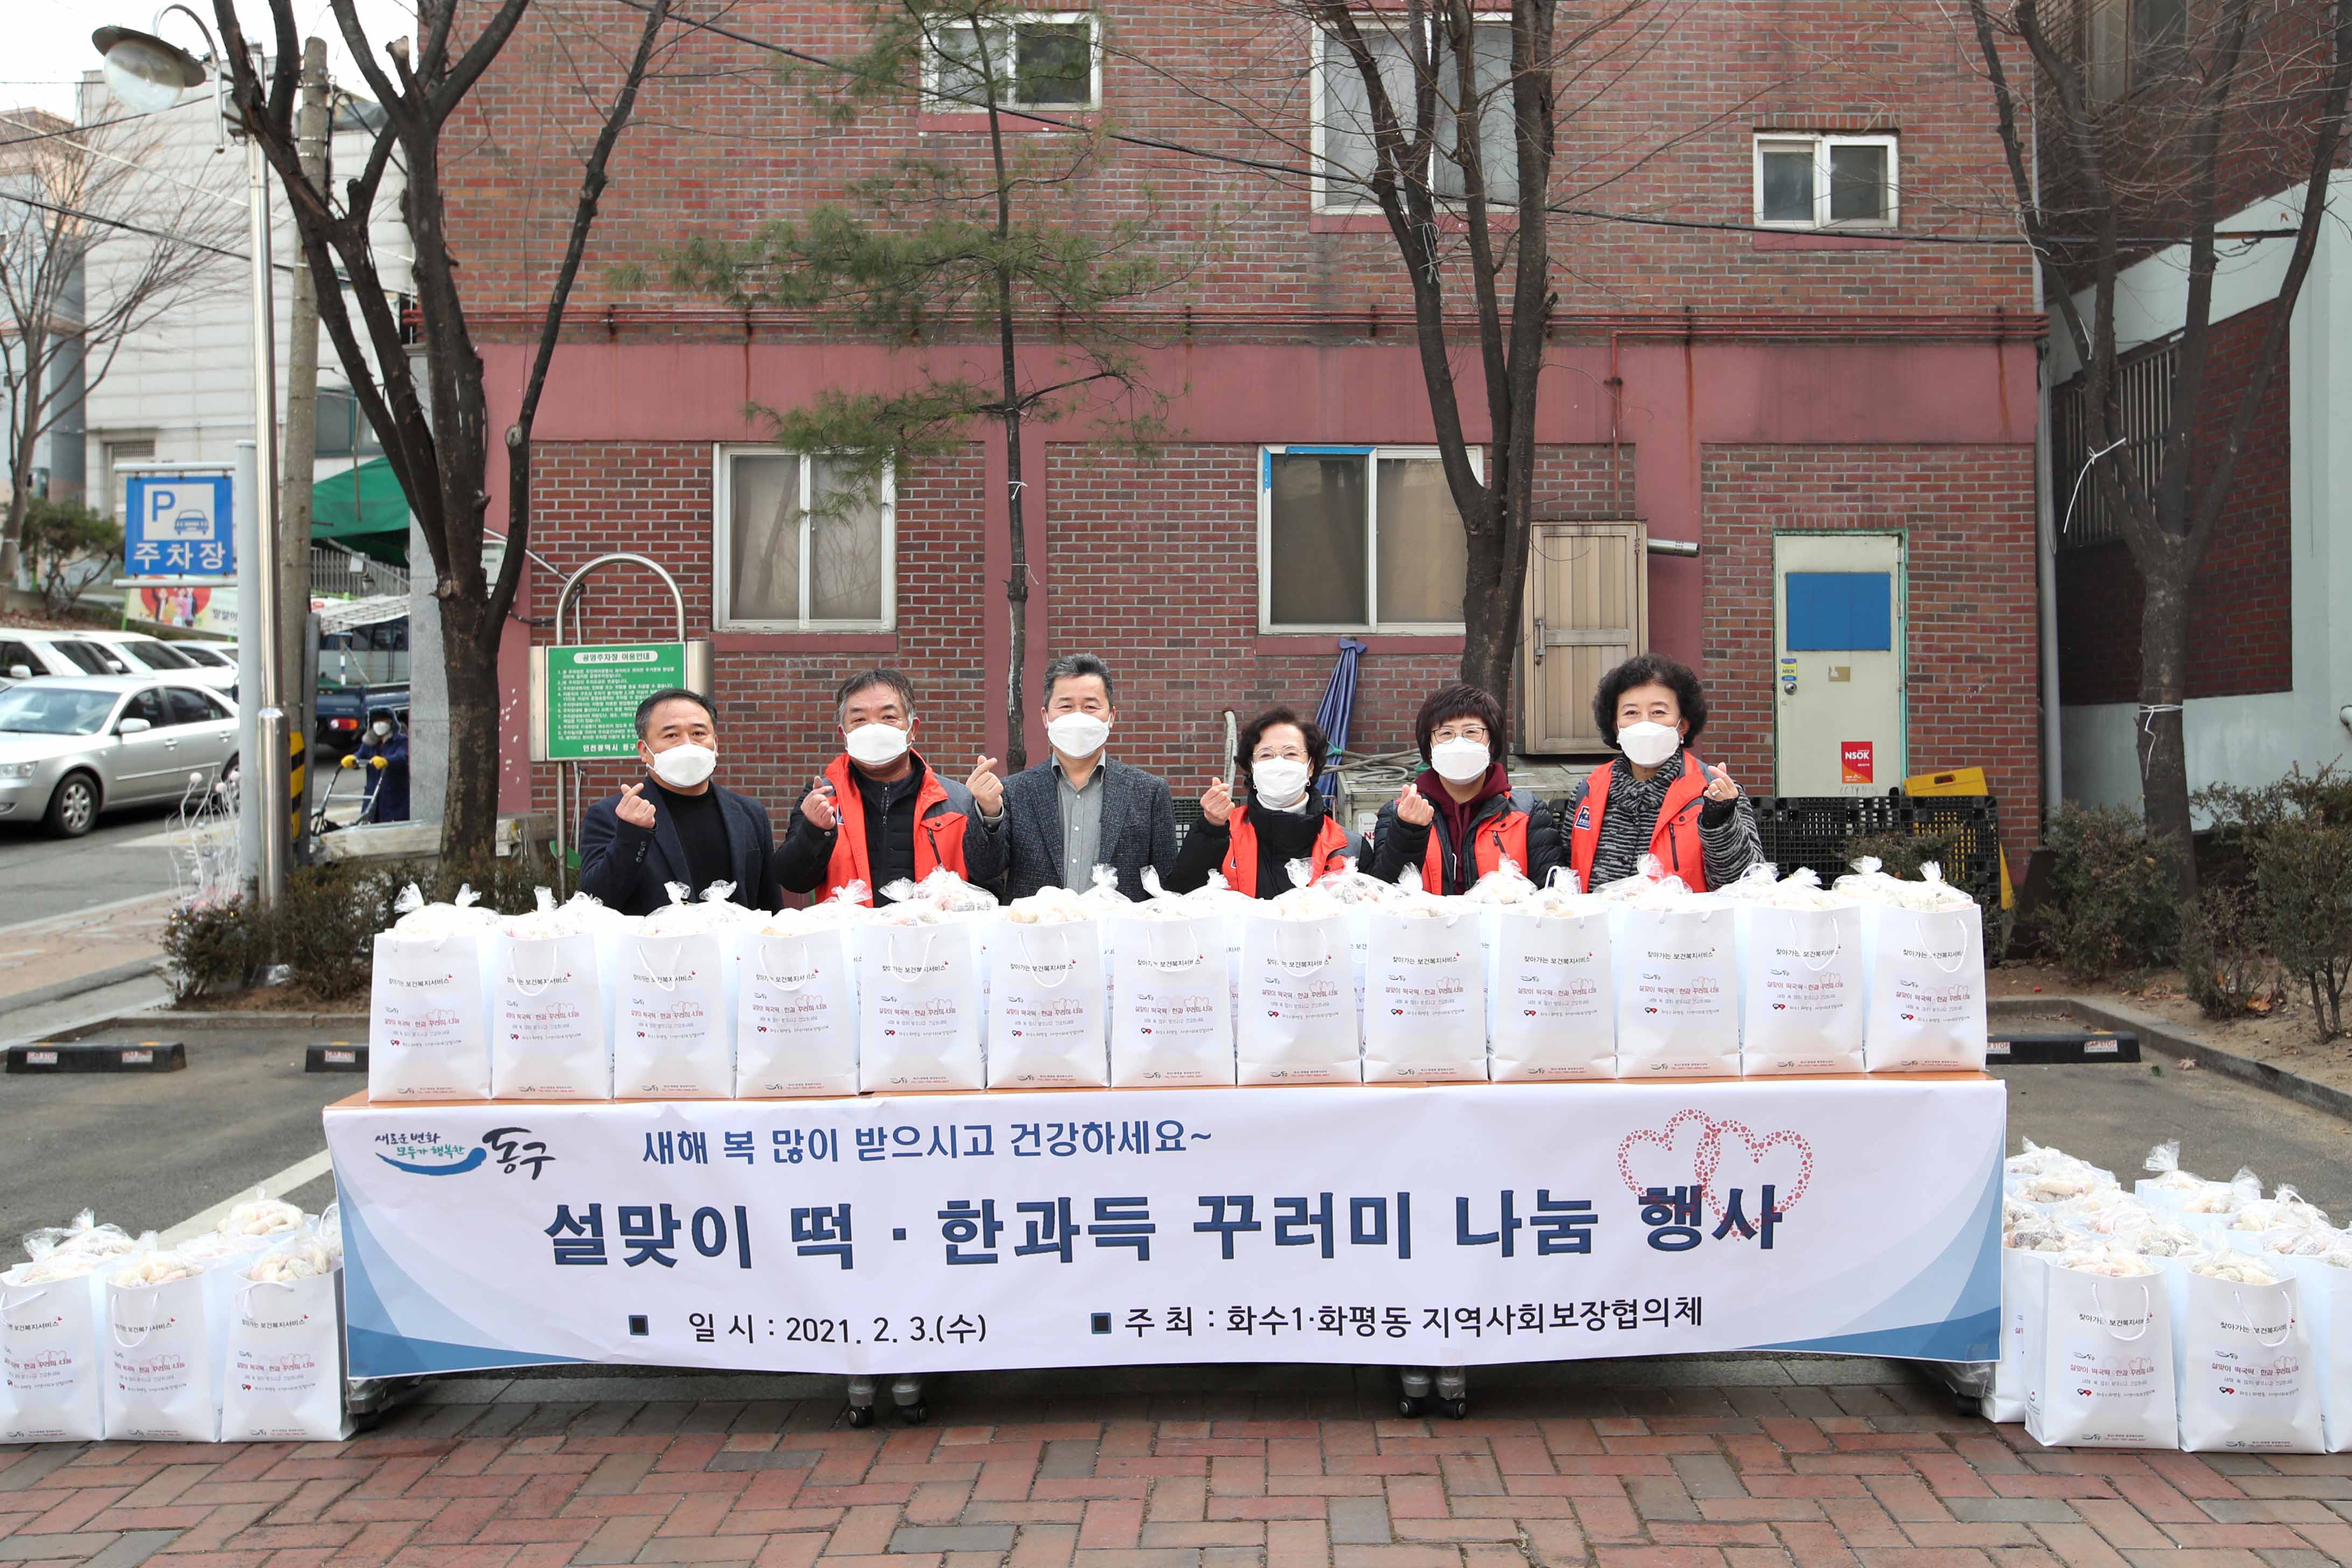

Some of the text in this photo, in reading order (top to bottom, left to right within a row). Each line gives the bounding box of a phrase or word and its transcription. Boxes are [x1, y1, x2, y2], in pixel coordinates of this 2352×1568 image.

[152, 491, 176, 522] P
[134, 541, 226, 570] 주차장
[621, 652, 650, 661] 이용안내
[583, 744, 619, 752] 인천광역시
[1845, 751, 1870, 760] NSOK
[1648, 951, 1671, 960] 찾아가는
[1776, 949, 1800, 957] 찾아가는
[1904, 949, 1963, 959] 찾아가는 건복지서비
[1393, 956, 1457, 965] 찾아가는 보건복지서비스
[1551, 956, 1590, 964] 보건복지서비스
[406, 978, 449, 987] 보건복지서비스
[375, 1133, 442, 1145] 새로운 변화
[642, 1119, 1213, 1165] 새해 복 많이 받으시고 건강하세요~
[396, 1144, 465, 1159] 모두가 행복한
[481, 1126, 556, 1180] 동구
[543, 1202, 752, 1270] 설맞이
[790, 1203, 855, 1271] 떡
[937, 1196, 1157, 1266] 한과득
[1192, 1191, 1412, 1260] 꾸러미
[1454, 1188, 1599, 1258] 나눔
[1638, 1184, 1784, 1252] 행사
[1226, 1305, 1412, 1339] 화수1·화평동
[1422, 1296, 1702, 1339] 지역사회보장협의체
[15, 1321, 58, 1331] 보건복지서비스
[261, 1319, 305, 1329] 보건복지서비스
[786, 1317, 862, 1345] 2021.
[873, 1317, 898, 1344] 2.
[909, 1313, 986, 1345] 3.(수)
[2221, 1322, 2292, 1334] 찾아가는 보건복지서비
